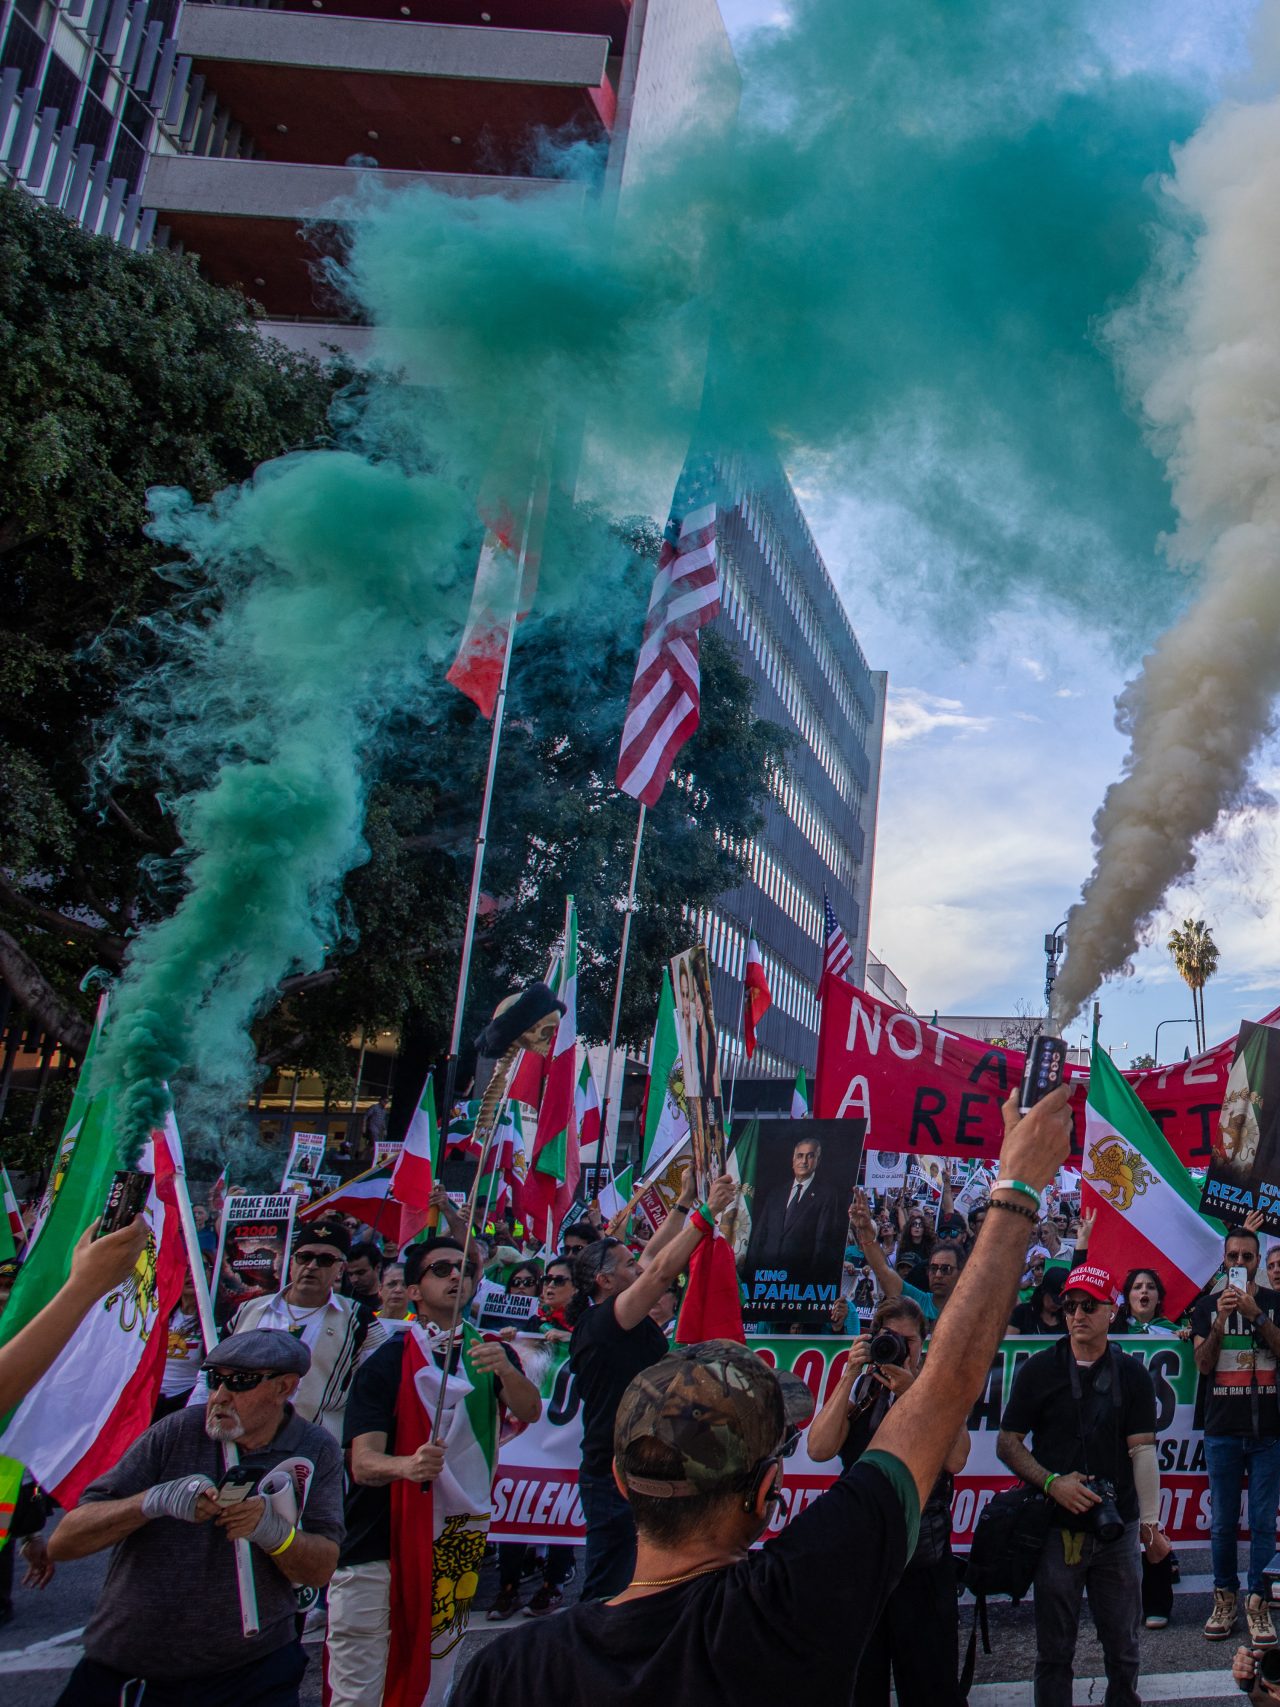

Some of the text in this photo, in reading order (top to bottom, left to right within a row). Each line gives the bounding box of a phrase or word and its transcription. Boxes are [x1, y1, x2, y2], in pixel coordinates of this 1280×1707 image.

[846, 996, 960, 1066] NOT
[968, 1051, 1008, 1089] A
[1207, 1180, 1253, 1208] REZA
[231, 1197, 291, 1209] MAKE IRAN
[229, 1208, 289, 1219] GREAT AGAIN
[235, 1225, 278, 1237] 12000
[233, 1259, 271, 1267] GENOCIDE
[754, 1269, 787, 1281] KING
[1069, 1275, 1105, 1288] GREAT AGAIN
[754, 1283, 837, 1300] PAHLAVI
[487, 1293, 532, 1307] MAKE IRAN
[484, 1303, 529, 1316] GREAT AGAIN
[1229, 1386, 1244, 1395] IRAN
